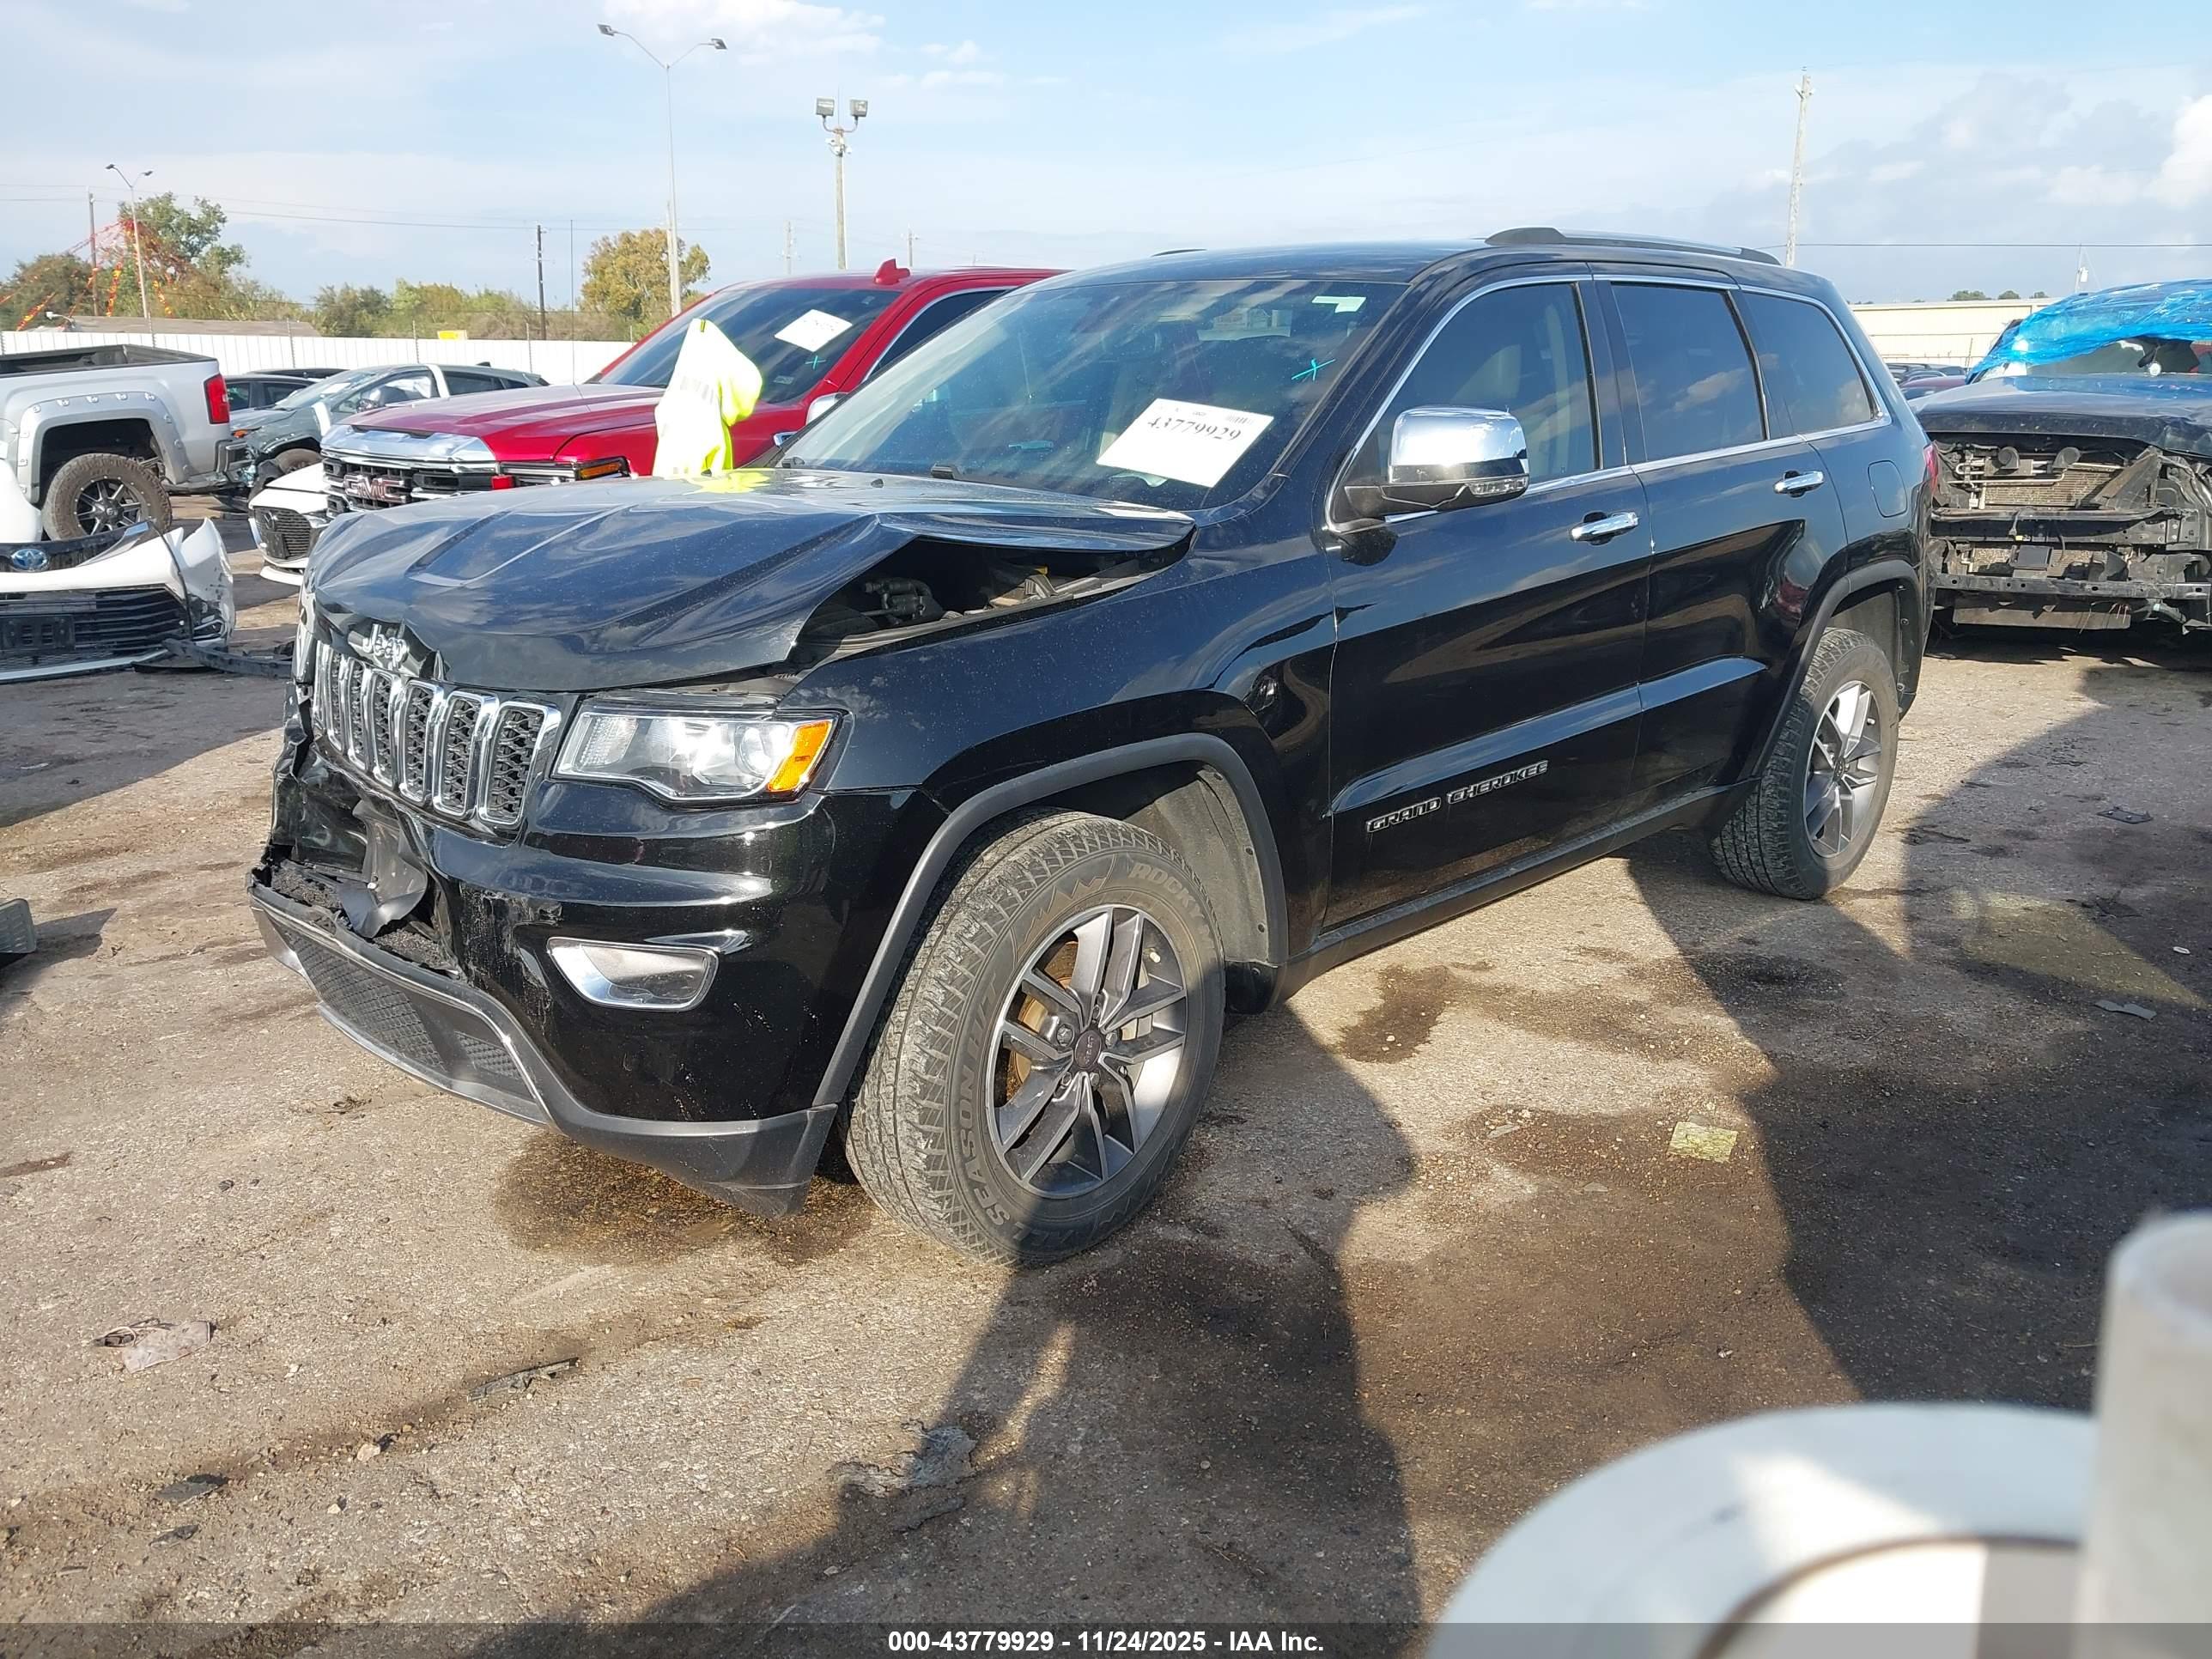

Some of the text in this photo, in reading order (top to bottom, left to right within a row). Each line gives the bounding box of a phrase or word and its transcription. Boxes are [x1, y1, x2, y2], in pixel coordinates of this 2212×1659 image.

[1147, 416, 1242, 441] 43779929
[343, 474, 406, 504] GMC
[362, 623, 410, 667] Jeep
[1365, 760, 1549, 833] GRAND CHEROKEE
[1127, 862, 1206, 919] ROCKY
[958, 1064, 1012, 1227] SEASON
